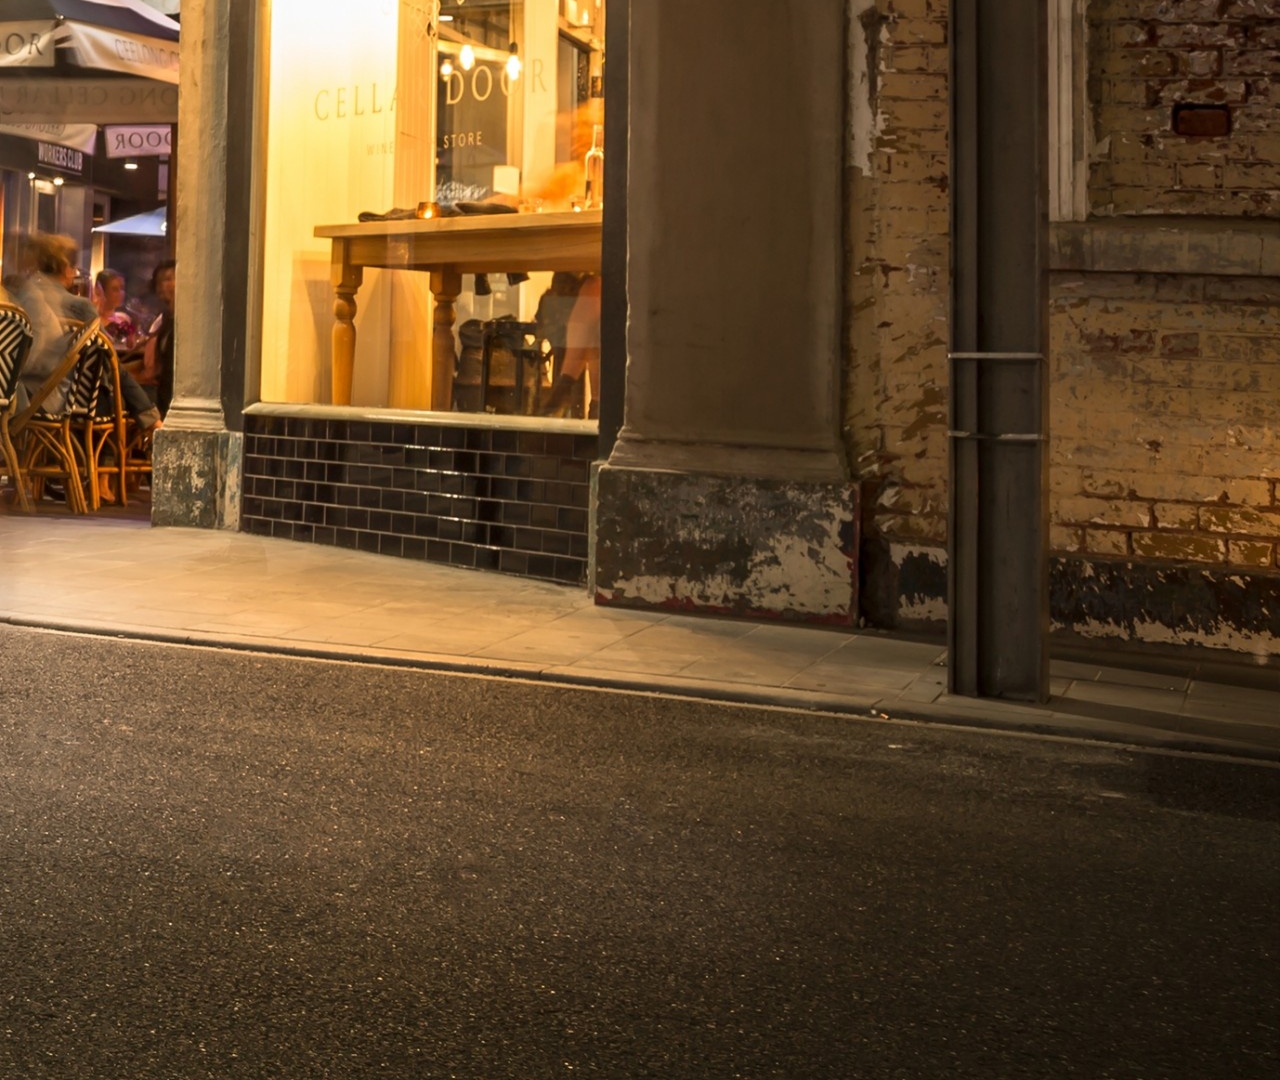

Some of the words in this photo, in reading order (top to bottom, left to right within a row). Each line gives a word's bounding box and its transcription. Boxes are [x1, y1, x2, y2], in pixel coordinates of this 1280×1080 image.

[314, 80, 410, 121] CELLA
[445, 57, 547, 105] DOOR
[443, 131, 483, 149] STORE
